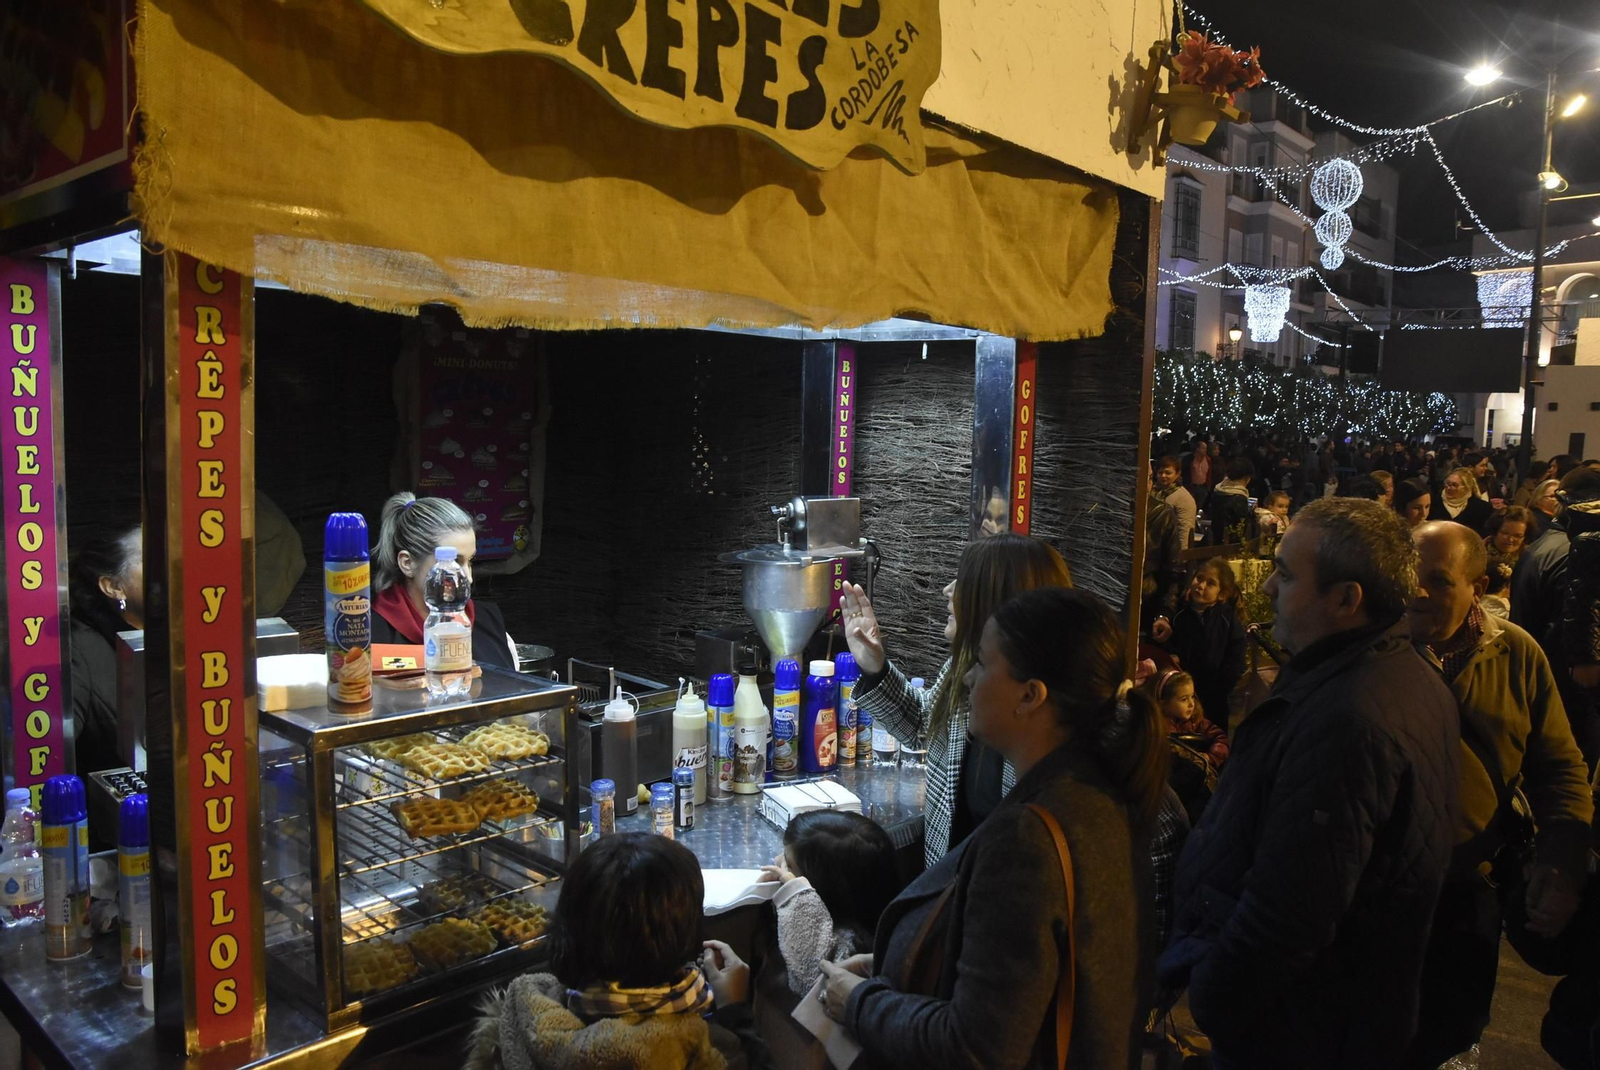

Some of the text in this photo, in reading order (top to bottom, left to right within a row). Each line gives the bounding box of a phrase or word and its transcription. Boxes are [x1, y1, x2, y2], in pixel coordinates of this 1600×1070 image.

[830, 20, 921, 131] CORDOBESA
[851, 40, 880, 72] LA
[9, 283, 45, 591] BUÑUELOS
[836, 360, 851, 485] BUÑUELOS
[1016, 379, 1031, 525] GOFRES
[22, 615, 44, 646] y
[194, 262, 239, 1016] CRÊPES y BUÑUELOS
